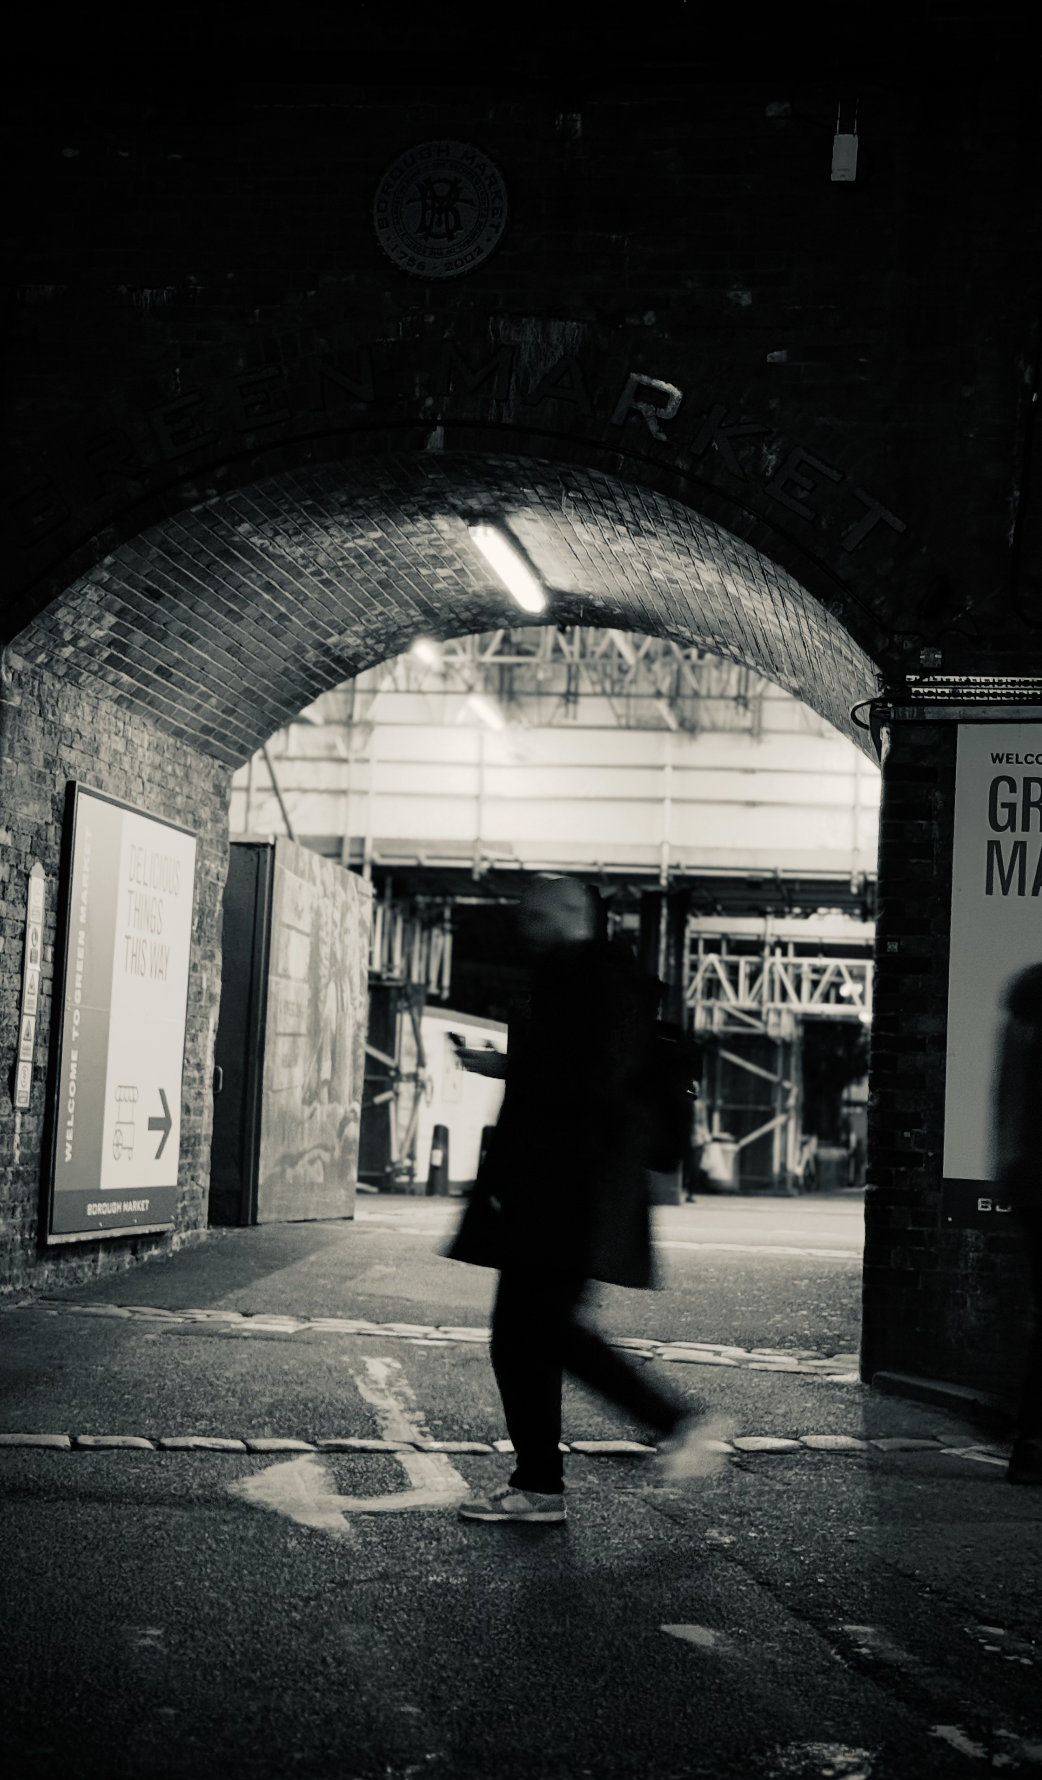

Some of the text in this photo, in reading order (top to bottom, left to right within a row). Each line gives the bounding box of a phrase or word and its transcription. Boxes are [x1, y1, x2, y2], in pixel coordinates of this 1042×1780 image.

[377, 144, 450, 230] BOROUGH
[461, 150, 504, 234] MARKET
[390, 243, 427, 272] 1756
[443, 245, 485, 272] 2002
[6, 339, 908, 553] GREEN MARKET
[128, 843, 181, 897] DELICIOUS
[127, 889, 164, 936] THINGS
[125, 934, 171, 981] THIS WAY
[64, 826, 93, 1163] WELCOME TO GREEN MARKET
[86, 1199, 150, 1216] BOROUGH MARKET
